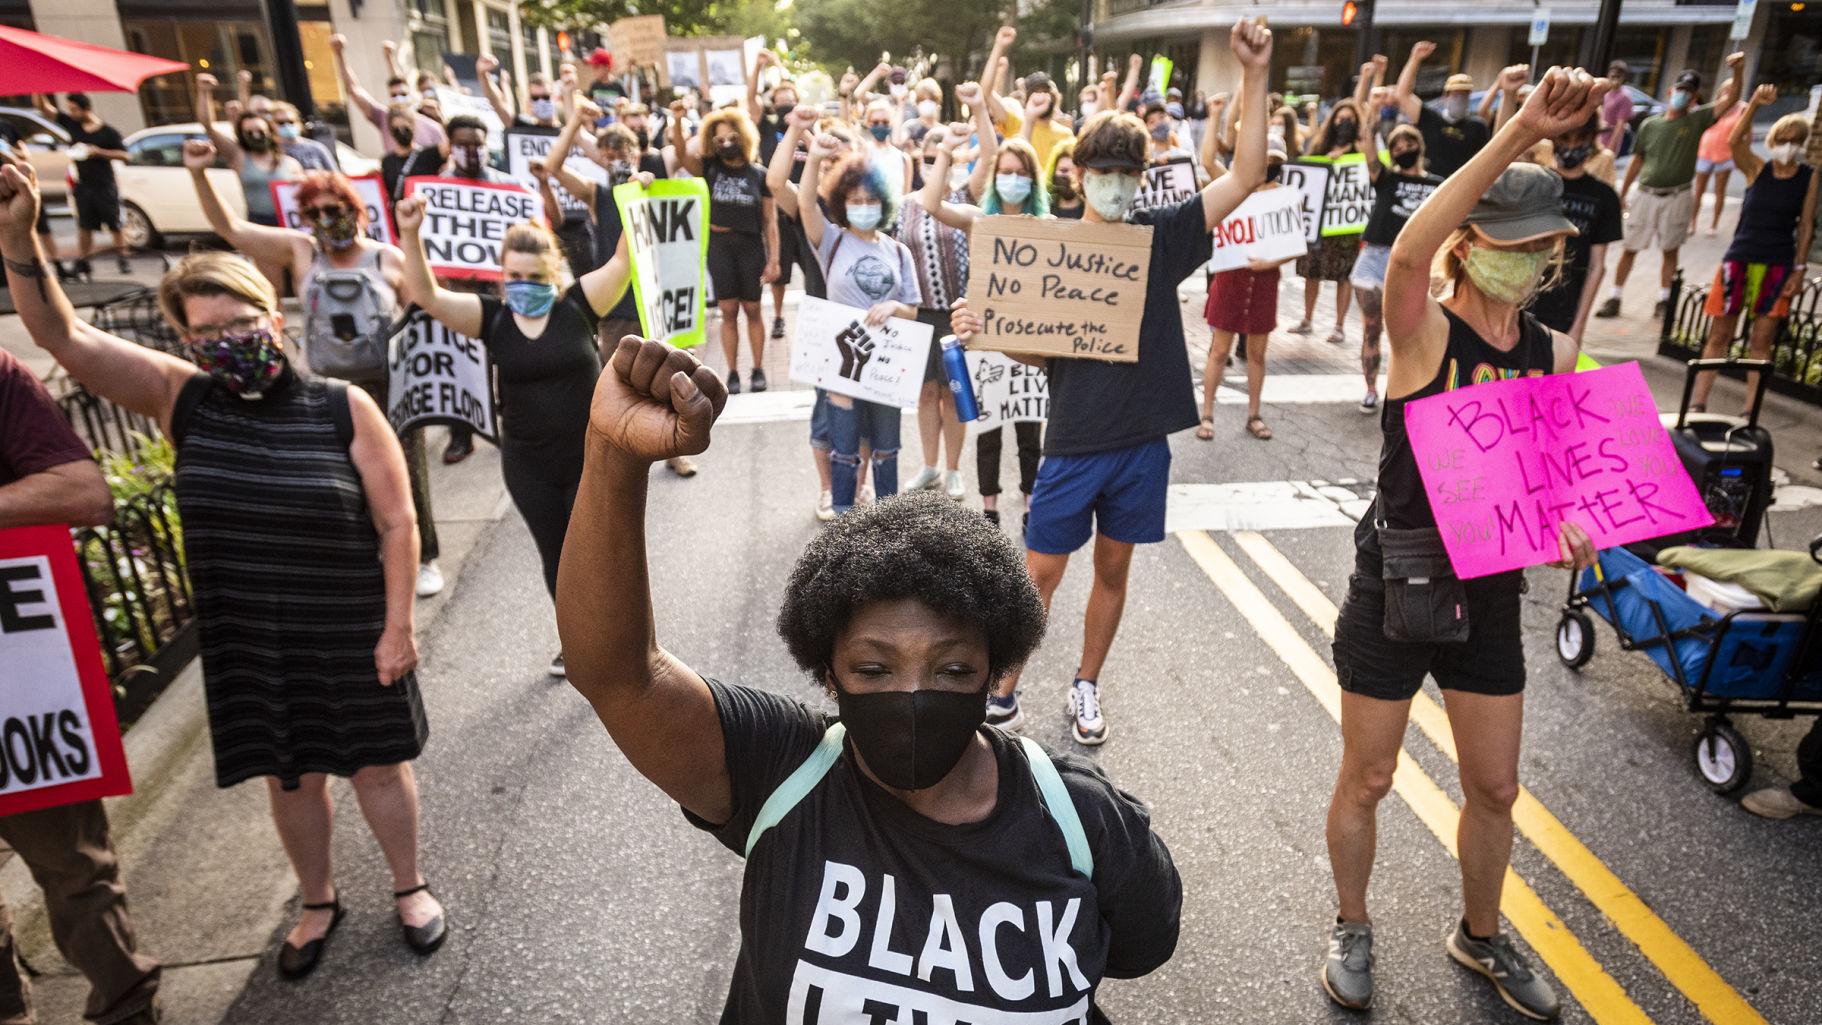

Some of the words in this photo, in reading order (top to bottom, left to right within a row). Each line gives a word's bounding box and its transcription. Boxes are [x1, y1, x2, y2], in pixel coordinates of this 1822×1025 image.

[422, 187, 534, 219] RELEASE
[426, 212, 515, 241] THE
[994, 237, 1038, 267] NO
[1047, 243, 1140, 281] Justice
[1041, 274, 1119, 306] Peace
[984, 308, 1078, 335] Prosecute
[1447, 382, 1611, 453] BLACK
[1515, 438, 1630, 495] LIVES
[1494, 479, 1687, 557] MATTER
[804, 860, 1090, 1001] BLACK
